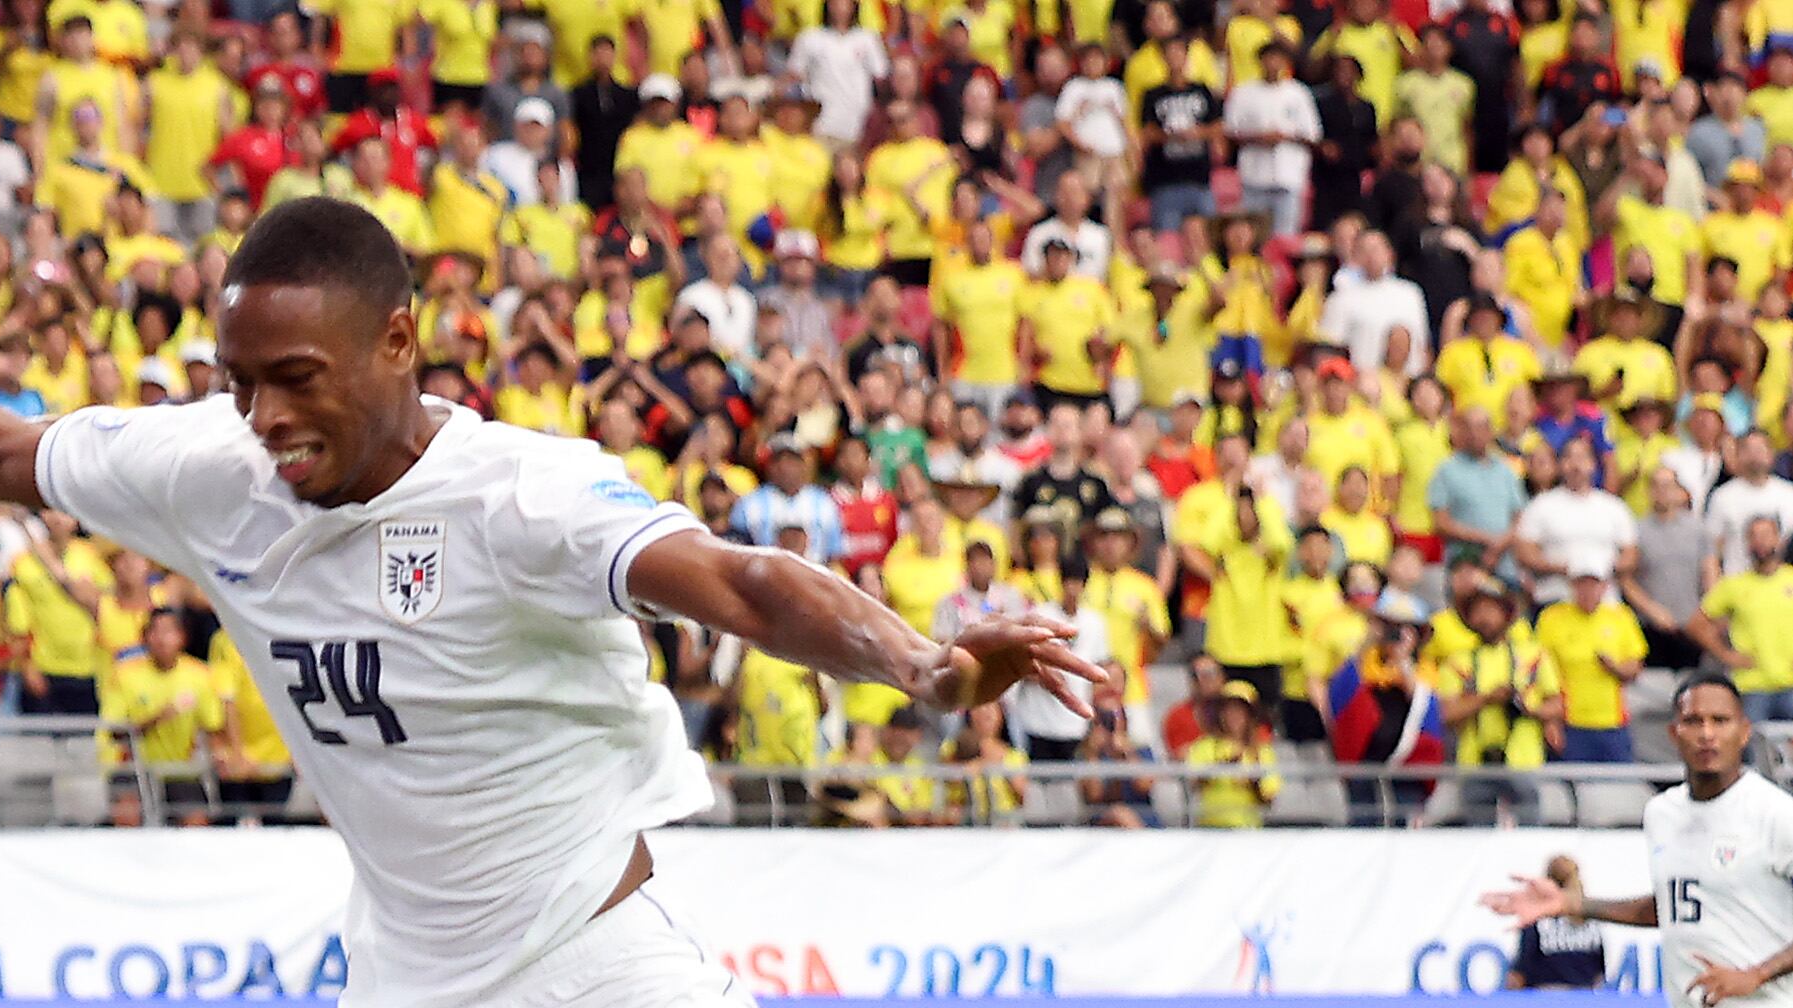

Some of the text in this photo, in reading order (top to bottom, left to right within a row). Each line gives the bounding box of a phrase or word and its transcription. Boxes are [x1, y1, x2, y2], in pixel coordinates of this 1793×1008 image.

[270, 639, 408, 745] 24
[1668, 878, 1701, 924] 15
[54, 941, 284, 1000] COPA
[721, 944, 840, 998] SA
[868, 943, 1056, 998] 2024
